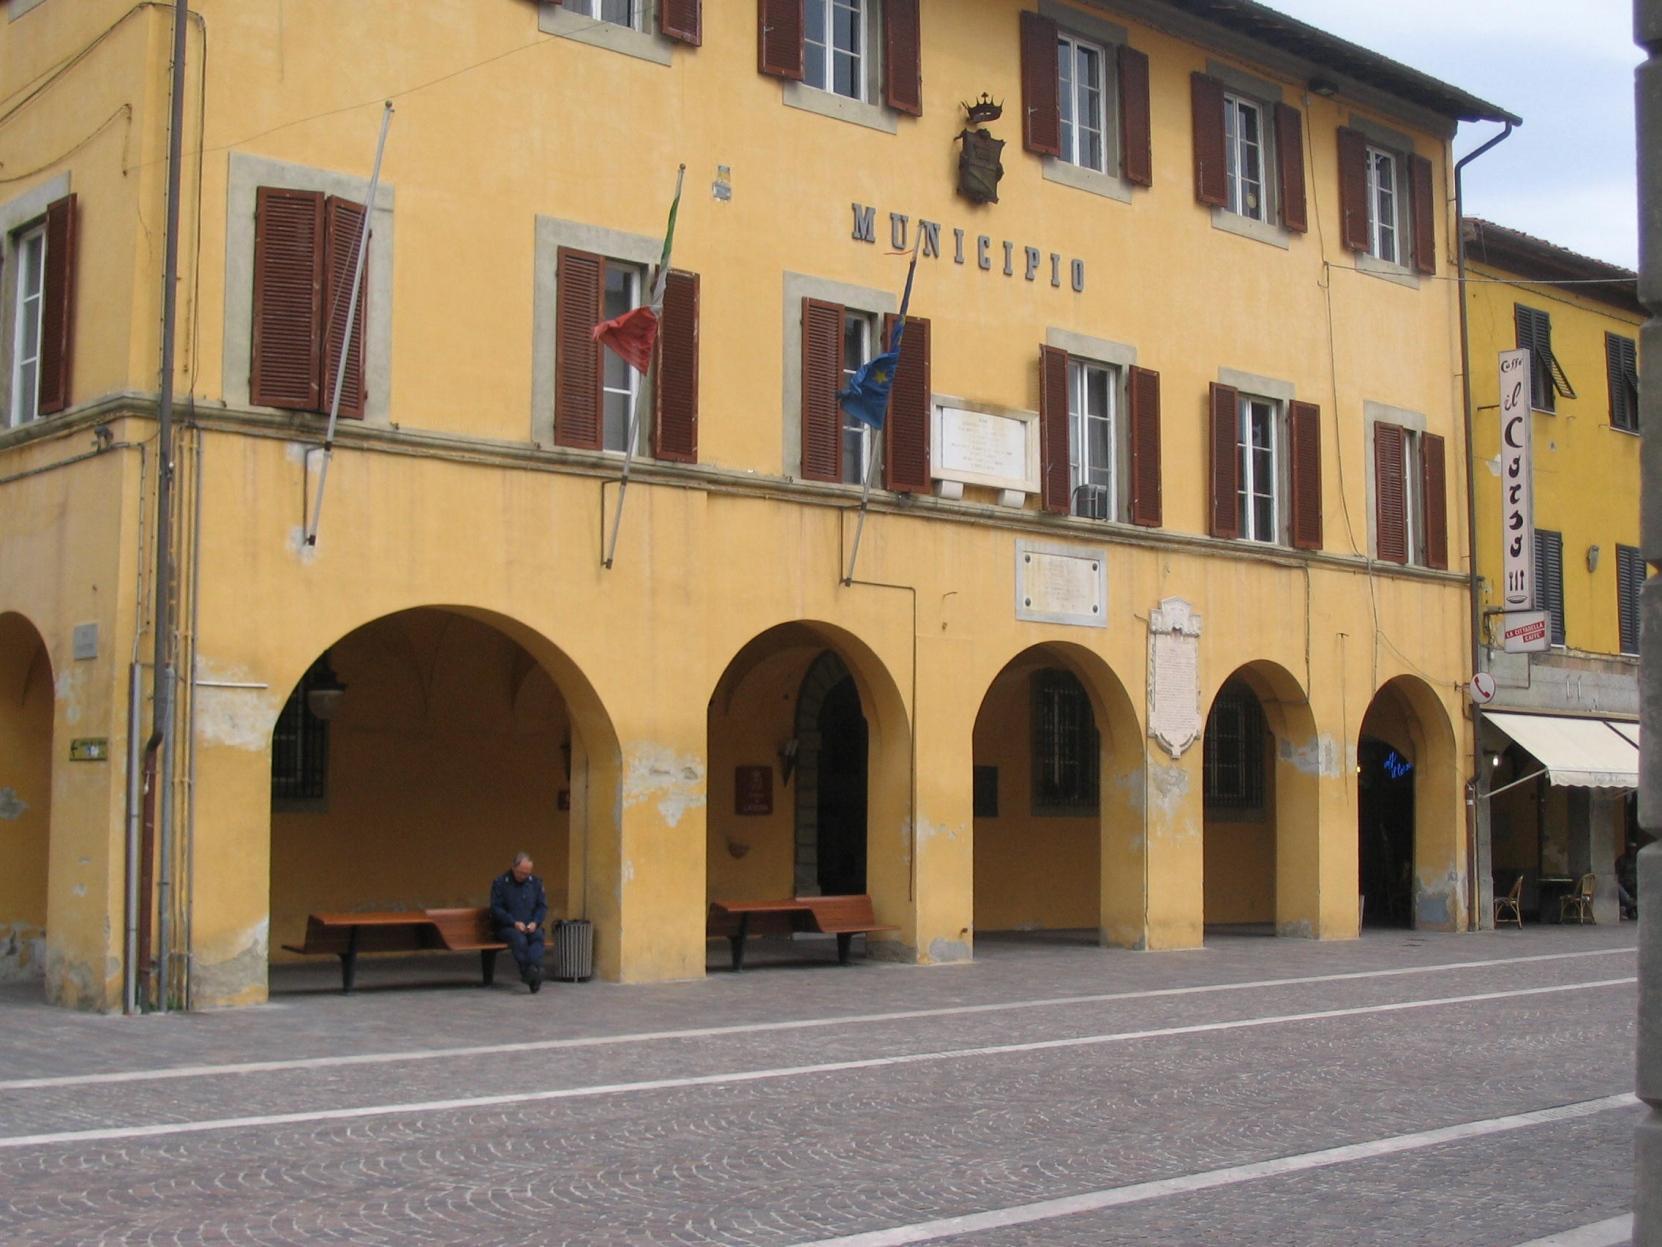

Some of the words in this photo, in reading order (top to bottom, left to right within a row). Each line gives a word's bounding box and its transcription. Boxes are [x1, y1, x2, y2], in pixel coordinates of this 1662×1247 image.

[852, 203, 1084, 292] MUNICIPIO
[1504, 382, 1522, 411] il
[1504, 416, 1524, 558] Corso
